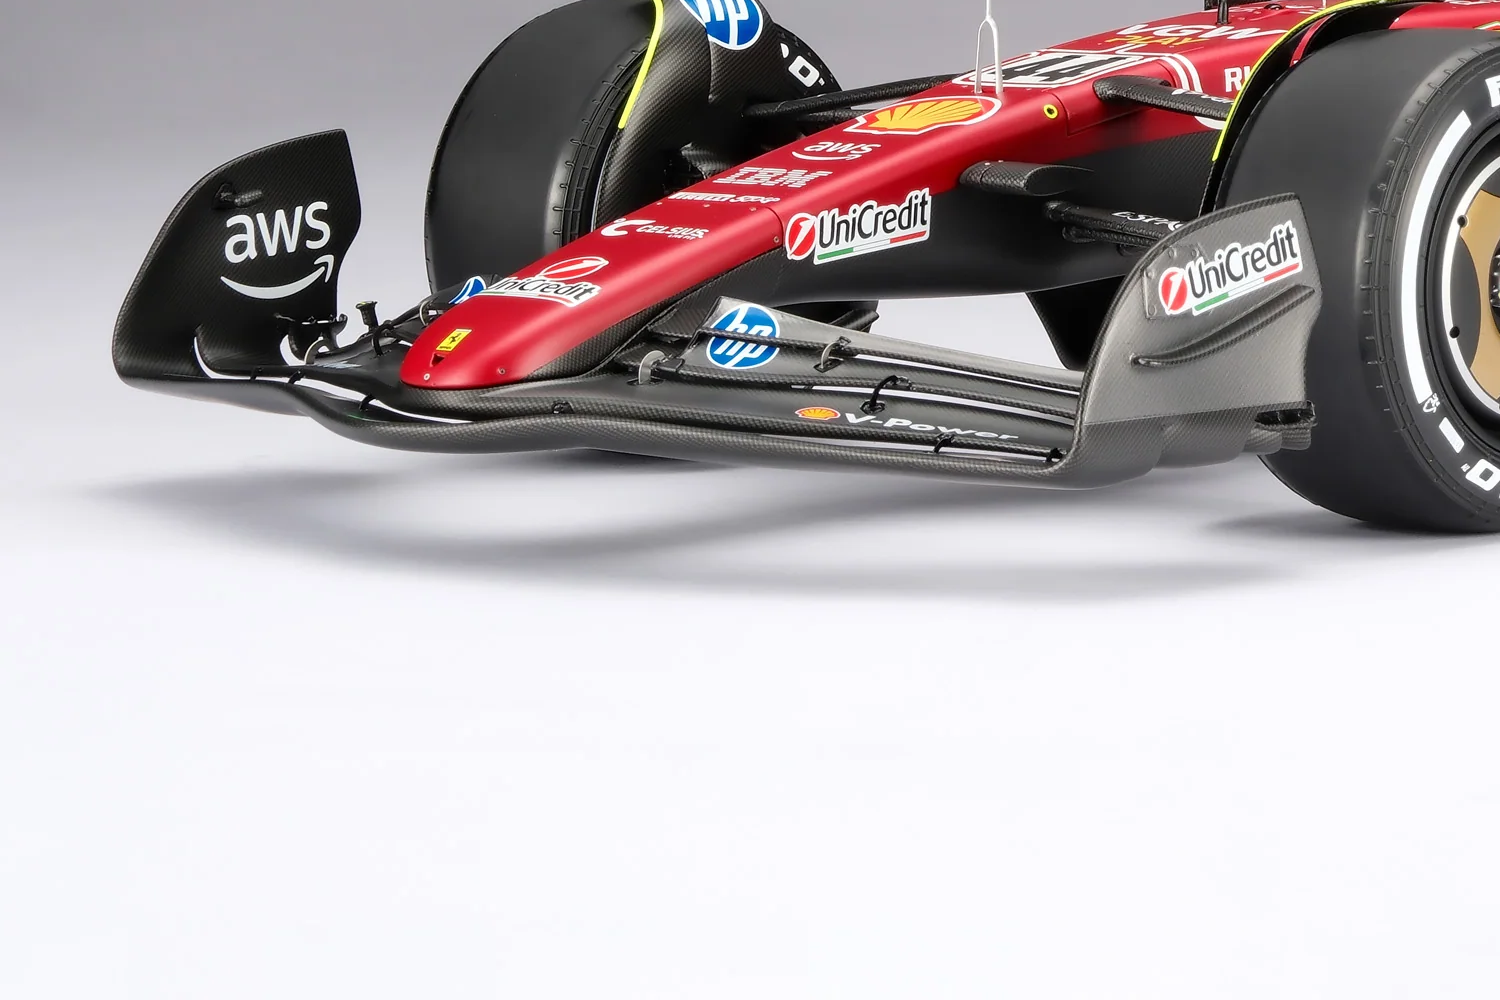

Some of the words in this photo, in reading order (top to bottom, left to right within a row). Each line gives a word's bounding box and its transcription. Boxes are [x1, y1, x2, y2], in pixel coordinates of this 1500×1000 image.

[803, 141, 881, 154] aws
[224, 200, 332, 264] aws
[818, 190, 929, 247] UniCredit
[1186, 224, 1299, 300] UniCredit
[712, 303, 775, 369] hp
[845, 412, 1019, 440] V-Power
